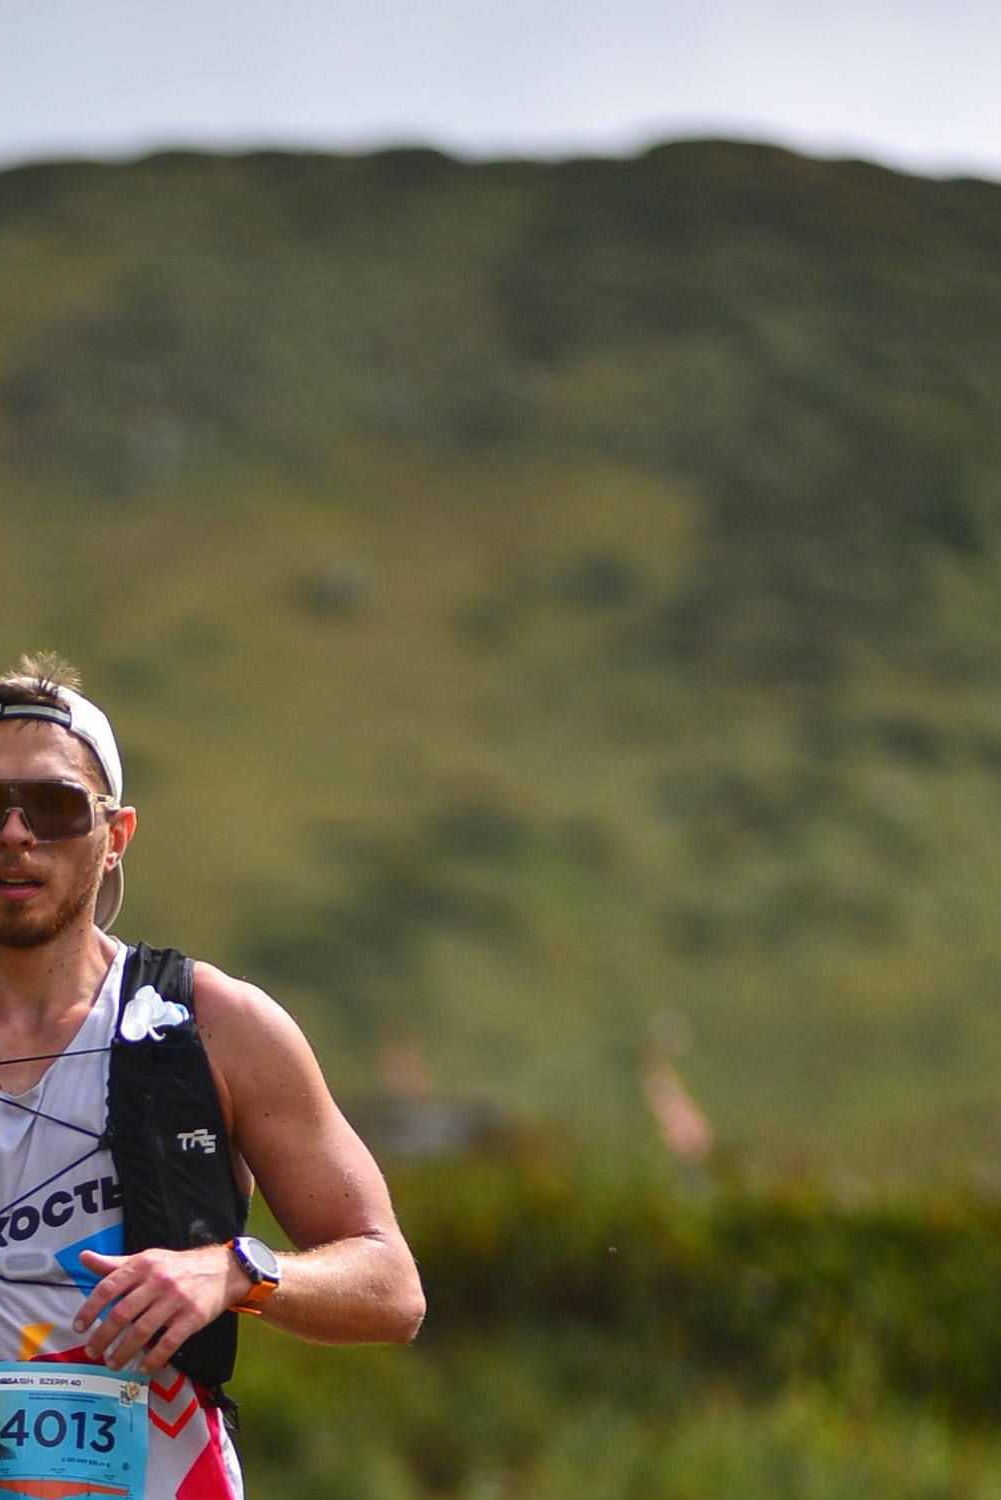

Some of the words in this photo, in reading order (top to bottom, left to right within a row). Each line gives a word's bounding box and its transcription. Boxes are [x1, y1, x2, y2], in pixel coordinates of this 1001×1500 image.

[177, 1129, 216, 1153] TRS
[70, 1379, 82, 1387] 40
[0, 1408, 117, 1453] 4013
